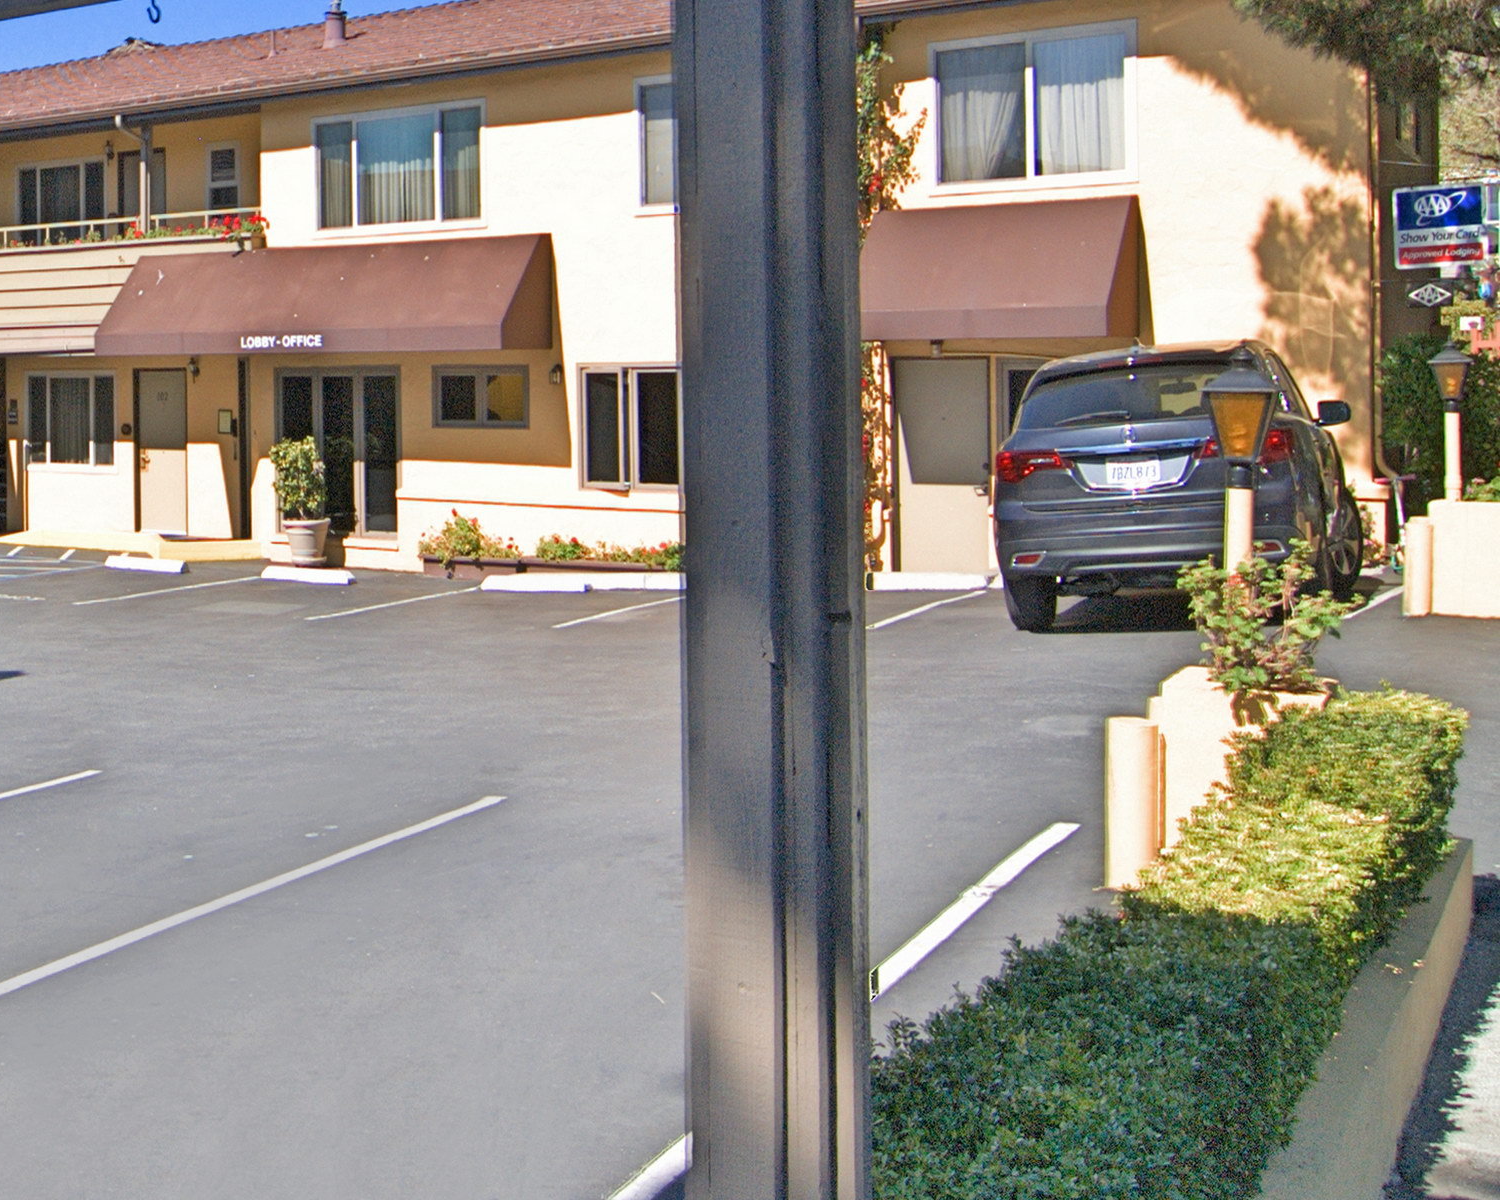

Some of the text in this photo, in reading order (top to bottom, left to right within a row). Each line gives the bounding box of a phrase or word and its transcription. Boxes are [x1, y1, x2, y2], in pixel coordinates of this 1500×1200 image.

[1415, 194, 1450, 217] AAA
[1400, 227, 1480, 243] Show Your Card
[1402, 248, 1480, 260] Approved Lodging
